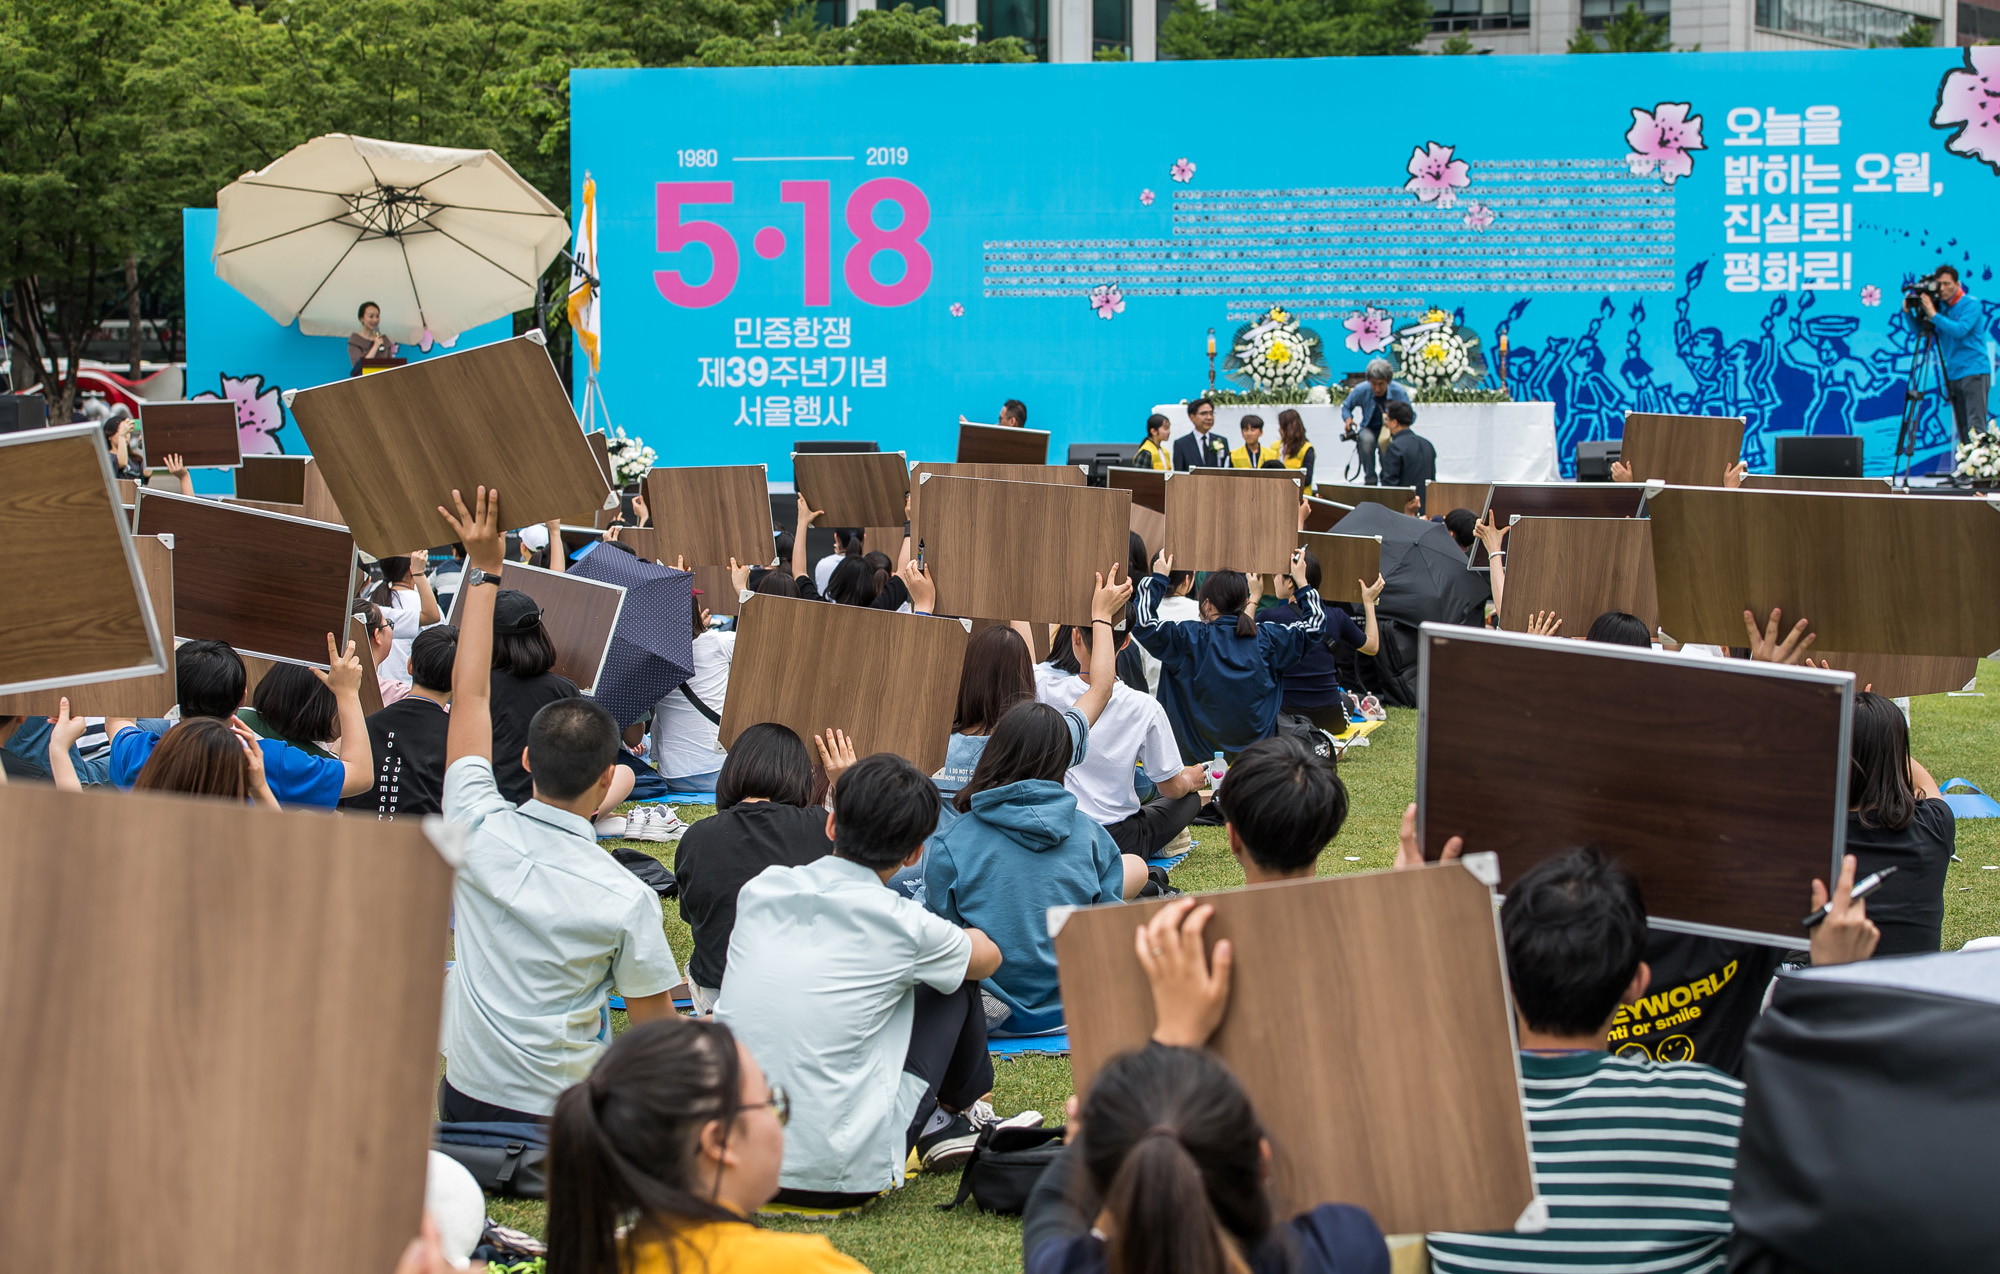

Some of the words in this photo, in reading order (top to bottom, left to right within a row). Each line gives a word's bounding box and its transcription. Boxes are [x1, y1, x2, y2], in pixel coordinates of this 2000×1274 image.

[1724, 106, 1841, 146] 오늘을
[677, 149, 717, 167] 1980
[867, 147, 908, 165] 2019
[1725, 155, 1841, 195] 밝히는
[1853, 152, 1943, 196] 오월,
[1724, 203, 1852, 243] 진실로!
[1724, 252, 1851, 292] 평화로!
[735, 317, 851, 348] 민중항쟁
[698, 356, 886, 387] 제39주년기념
[734, 396, 852, 426] 서울행사
[387, 732, 395, 748] no
[1631, 1022, 1652, 1037] or
[1655, 1006, 1702, 1030] smile
